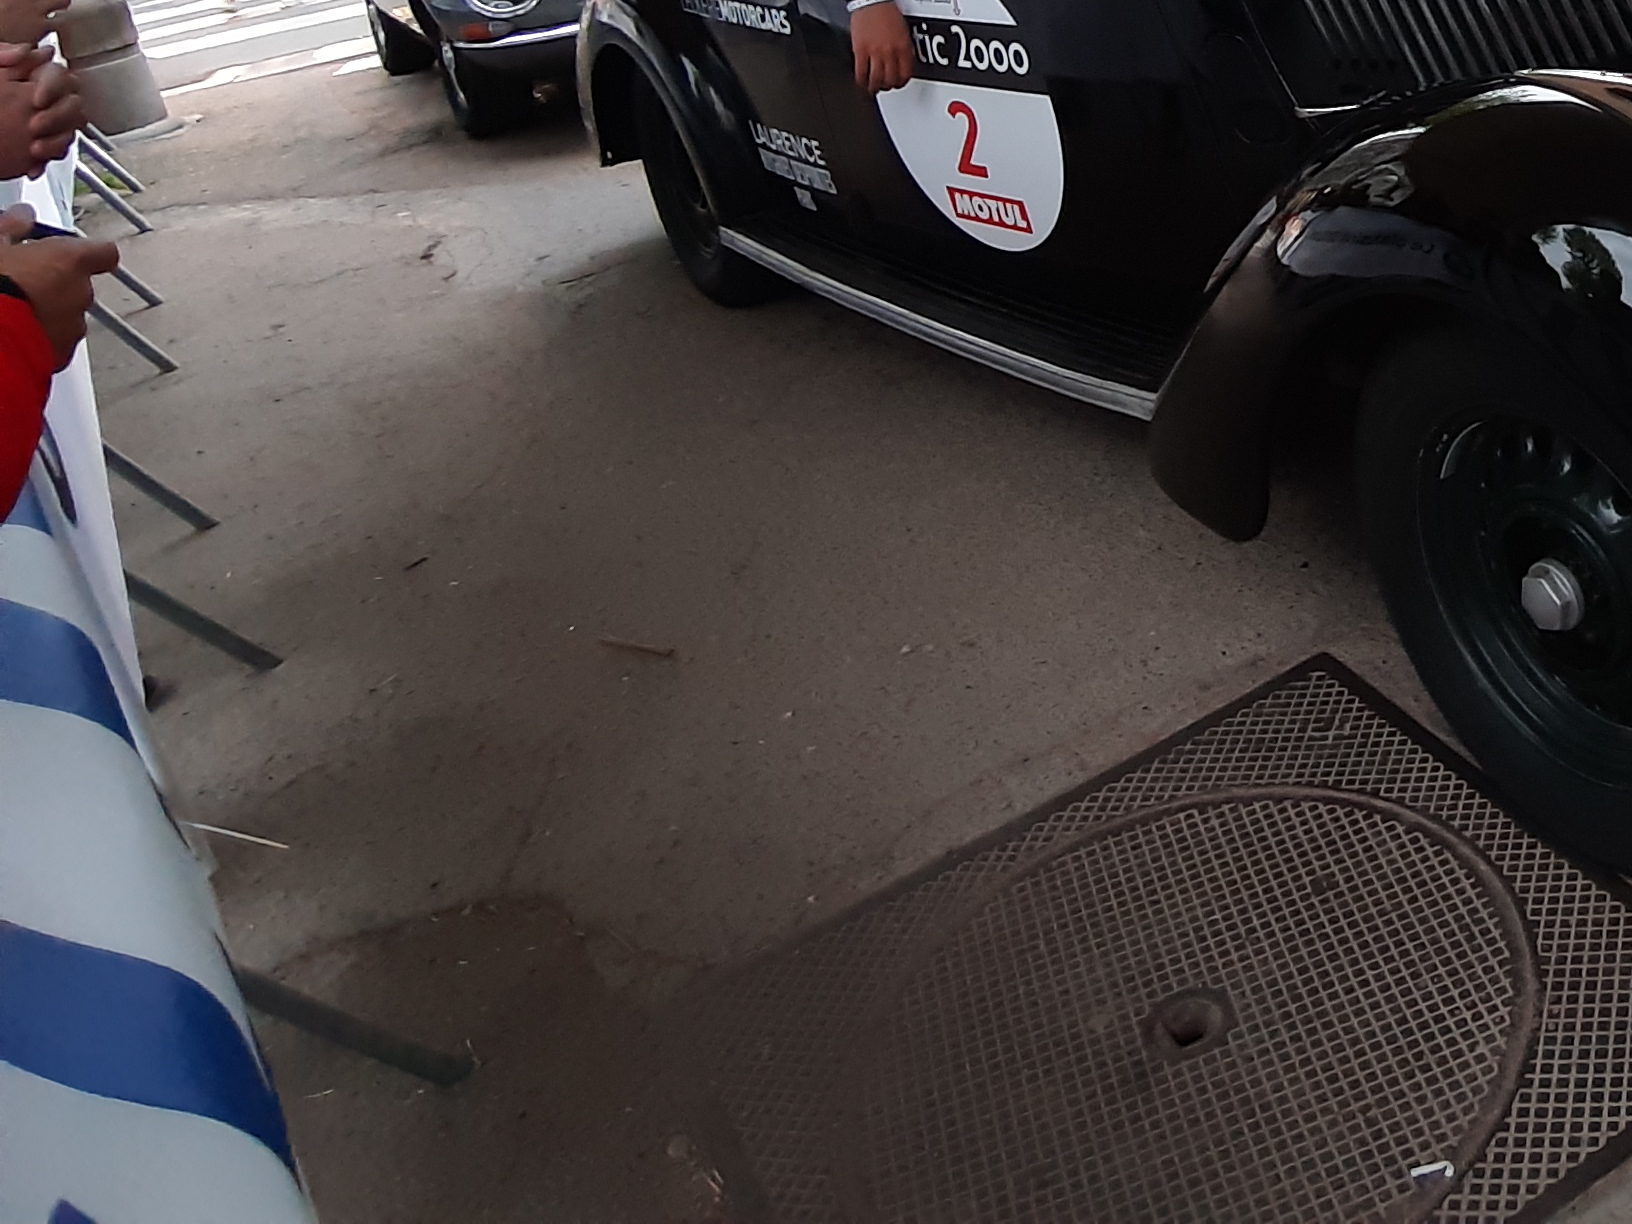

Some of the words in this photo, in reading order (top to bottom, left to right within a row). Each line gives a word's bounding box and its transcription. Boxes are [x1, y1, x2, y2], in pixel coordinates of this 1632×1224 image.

[911, 22, 949, 66] tic
[950, 24, 1030, 76] 2000
[748, 119, 827, 166] LAURENCE
[947, 100, 989, 179] 2
[953, 191, 1028, 229] MOTUL
